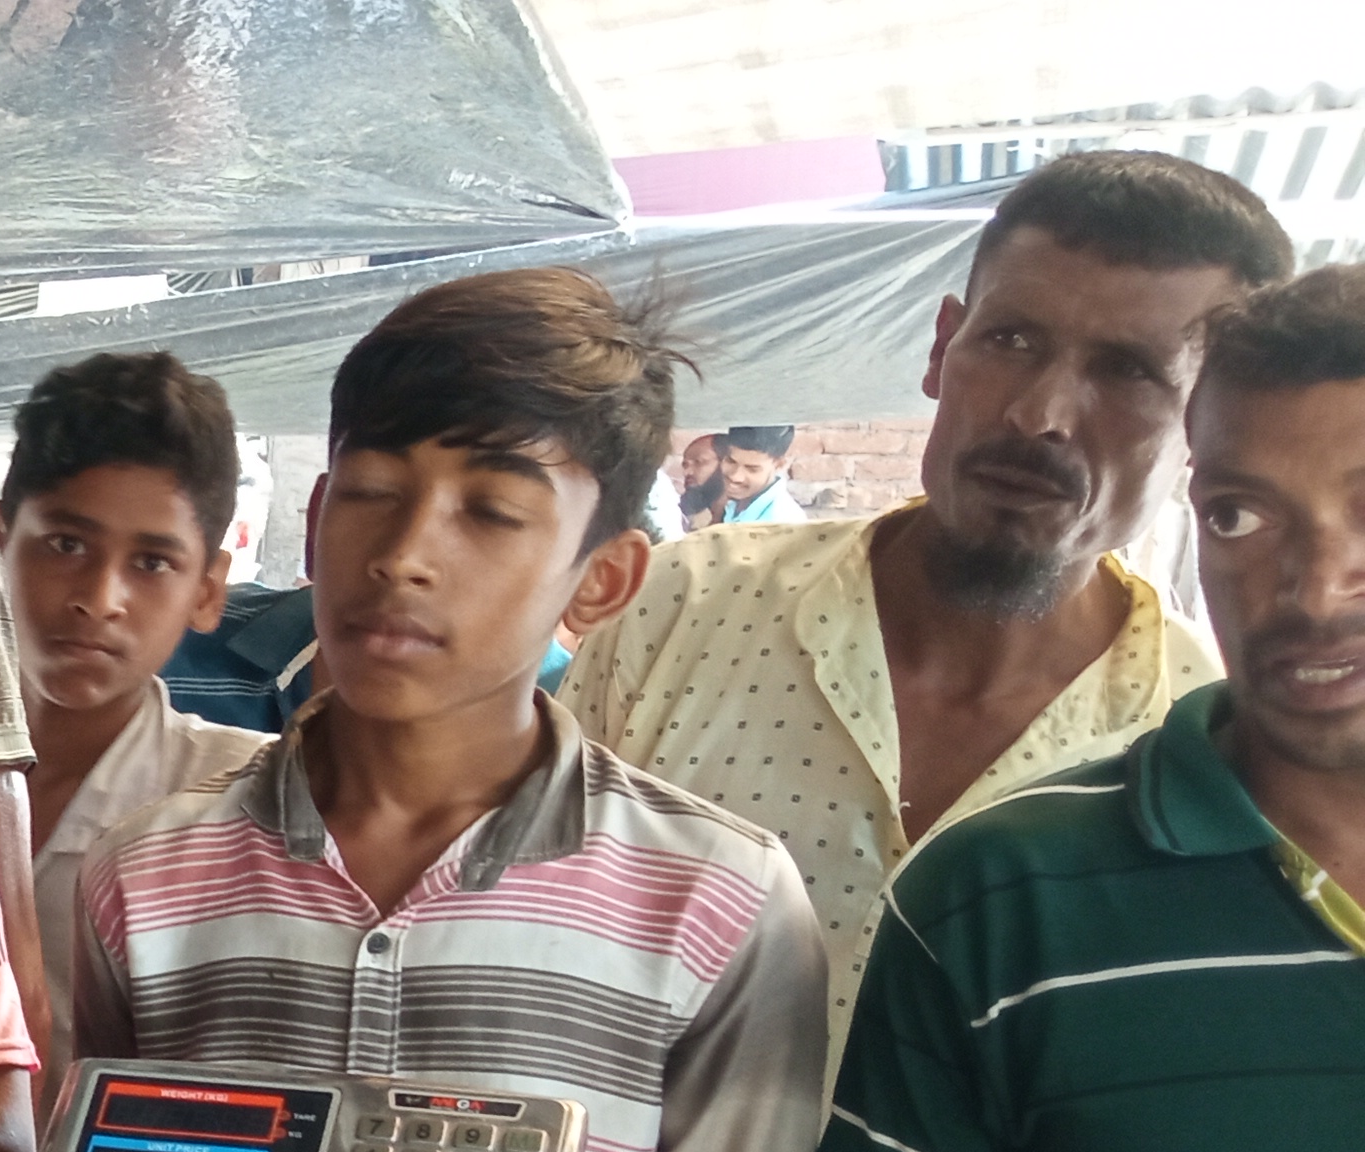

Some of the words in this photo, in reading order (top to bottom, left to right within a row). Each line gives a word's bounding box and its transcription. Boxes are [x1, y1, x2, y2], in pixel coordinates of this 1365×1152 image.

[161, 1088, 202, 1101] WEIGHT
[370, 1118, 384, 1135] 7
[416, 1123, 431, 1139] 8
[464, 1128, 480, 1143] 9
[147, 1142, 174, 1152] UNIT
